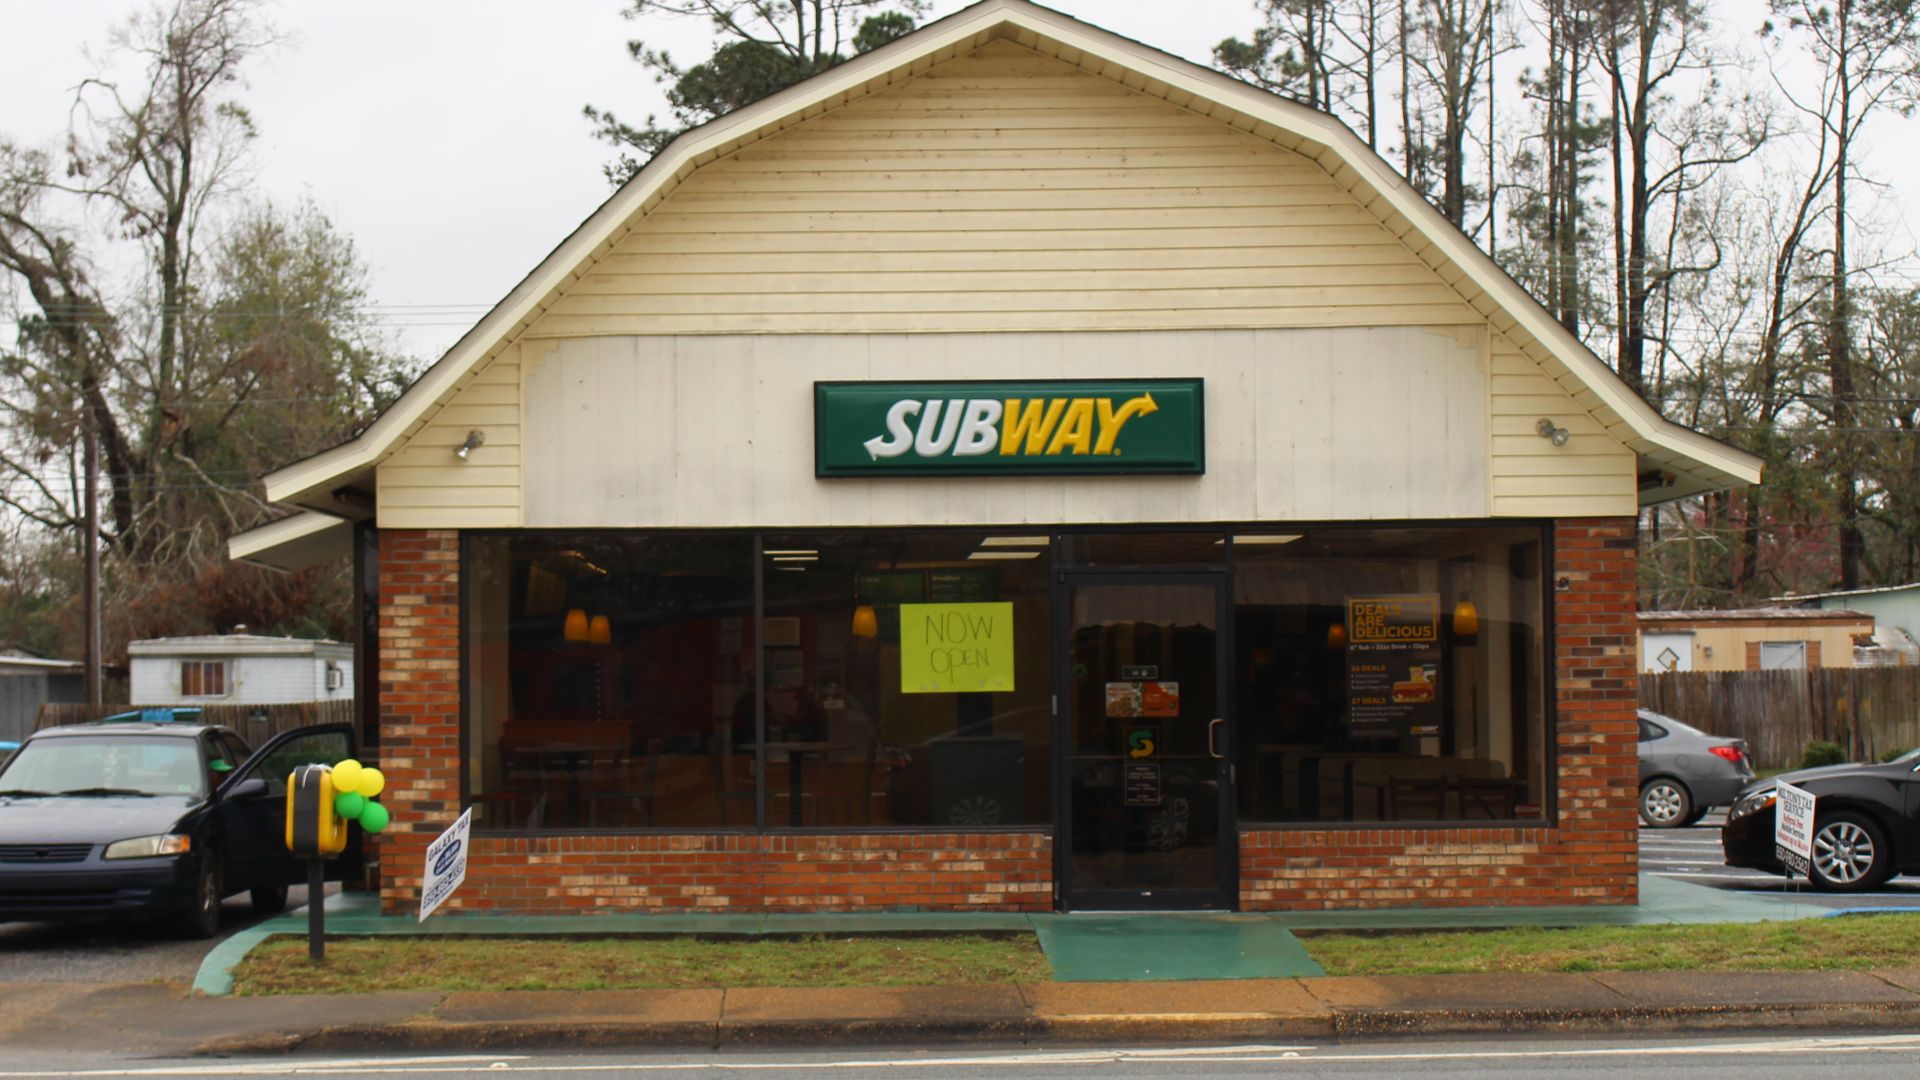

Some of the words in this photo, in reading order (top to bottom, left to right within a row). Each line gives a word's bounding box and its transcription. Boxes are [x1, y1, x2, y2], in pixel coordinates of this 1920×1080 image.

[864, 391, 1158, 461] SUBWAY
[1355, 604, 1401, 615] DEALS
[926, 610, 993, 645] NOW
[1356, 614, 1384, 626] ARE
[1356, 625, 1432, 638] DELICIOUS
[930, 647, 989, 683] OPEN
[1361, 664, 1387, 672] DEALS
[1783, 800, 1804, 818] SERVICE
[428, 830, 456, 862] GALAXY
[457, 816, 469, 834] TAX
